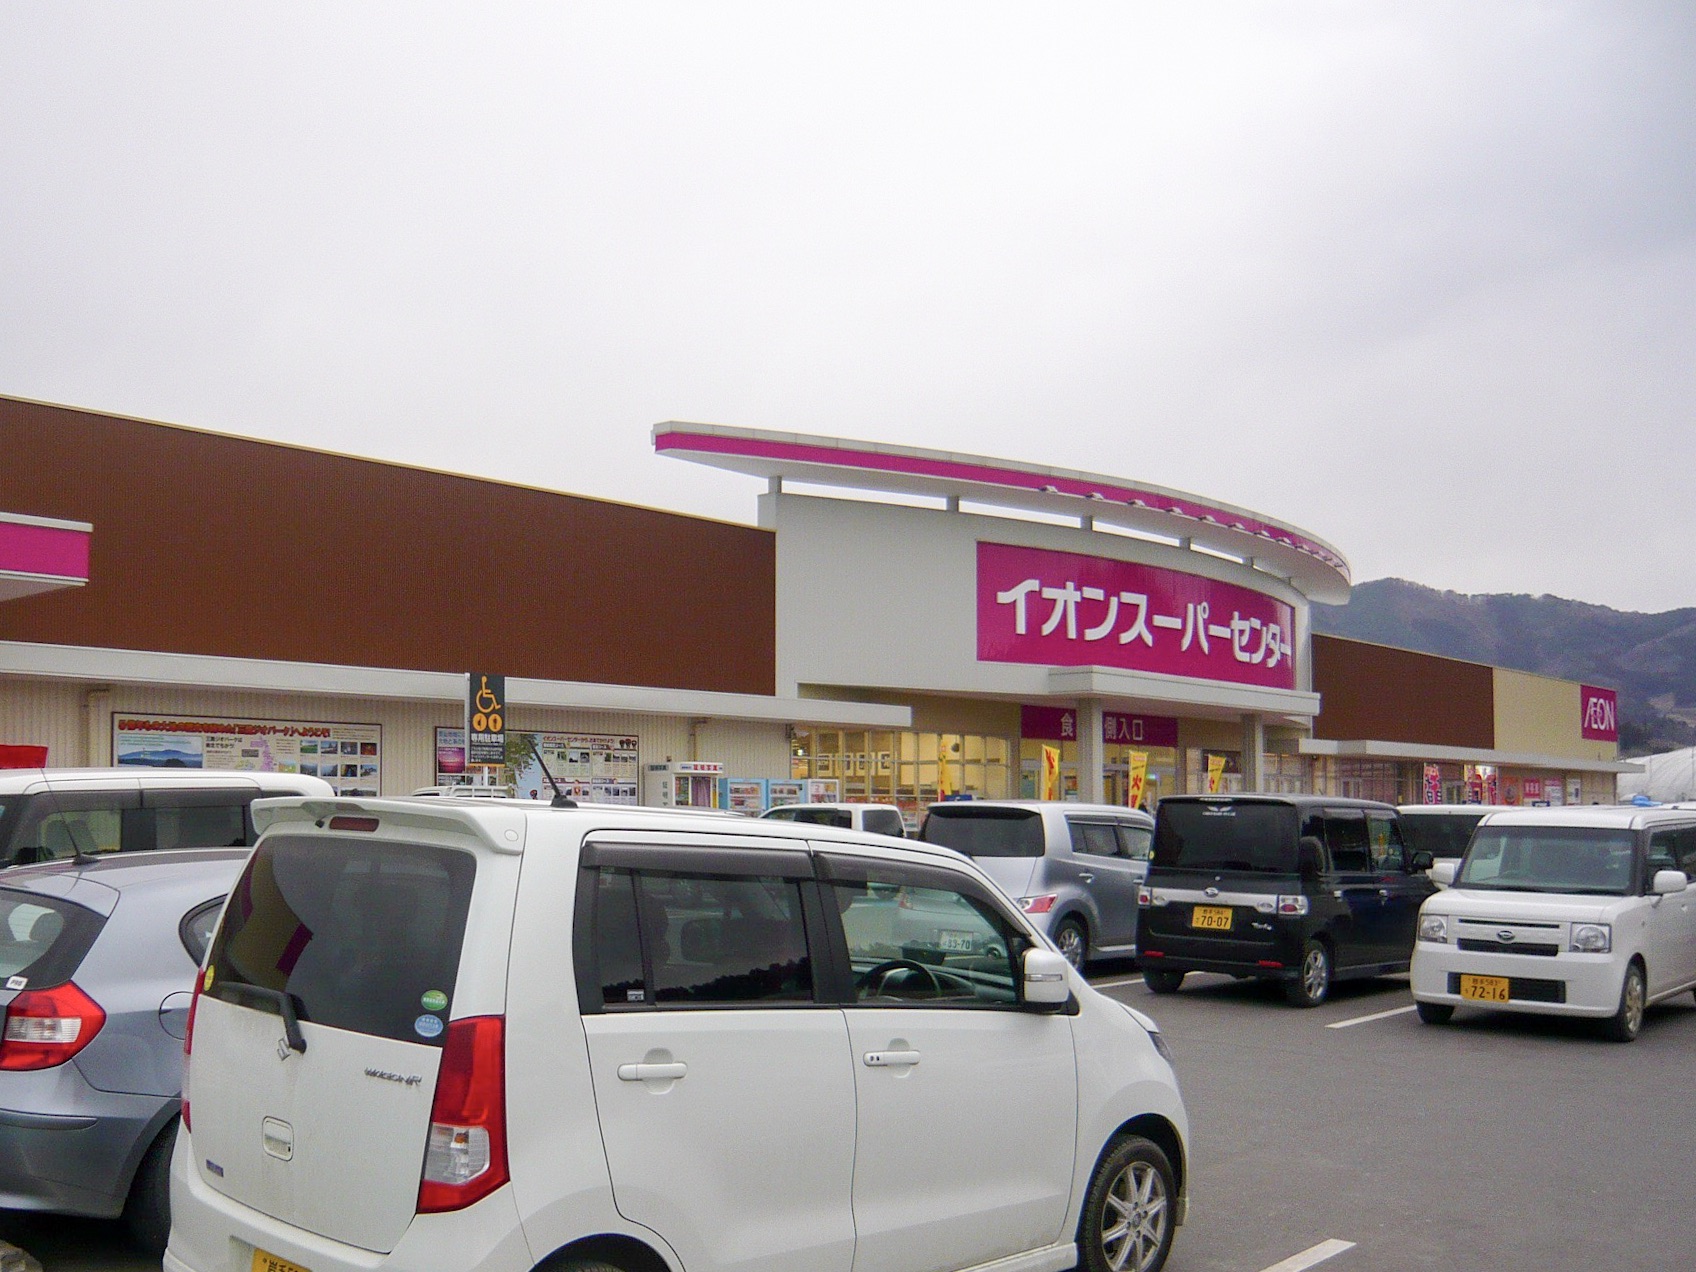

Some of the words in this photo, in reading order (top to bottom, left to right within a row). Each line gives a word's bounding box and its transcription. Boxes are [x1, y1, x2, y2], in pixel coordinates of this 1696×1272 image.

[996, 579, 1292, 669] イオンスーパーセンター
[1471, 985, 1506, 1000] 72-16
